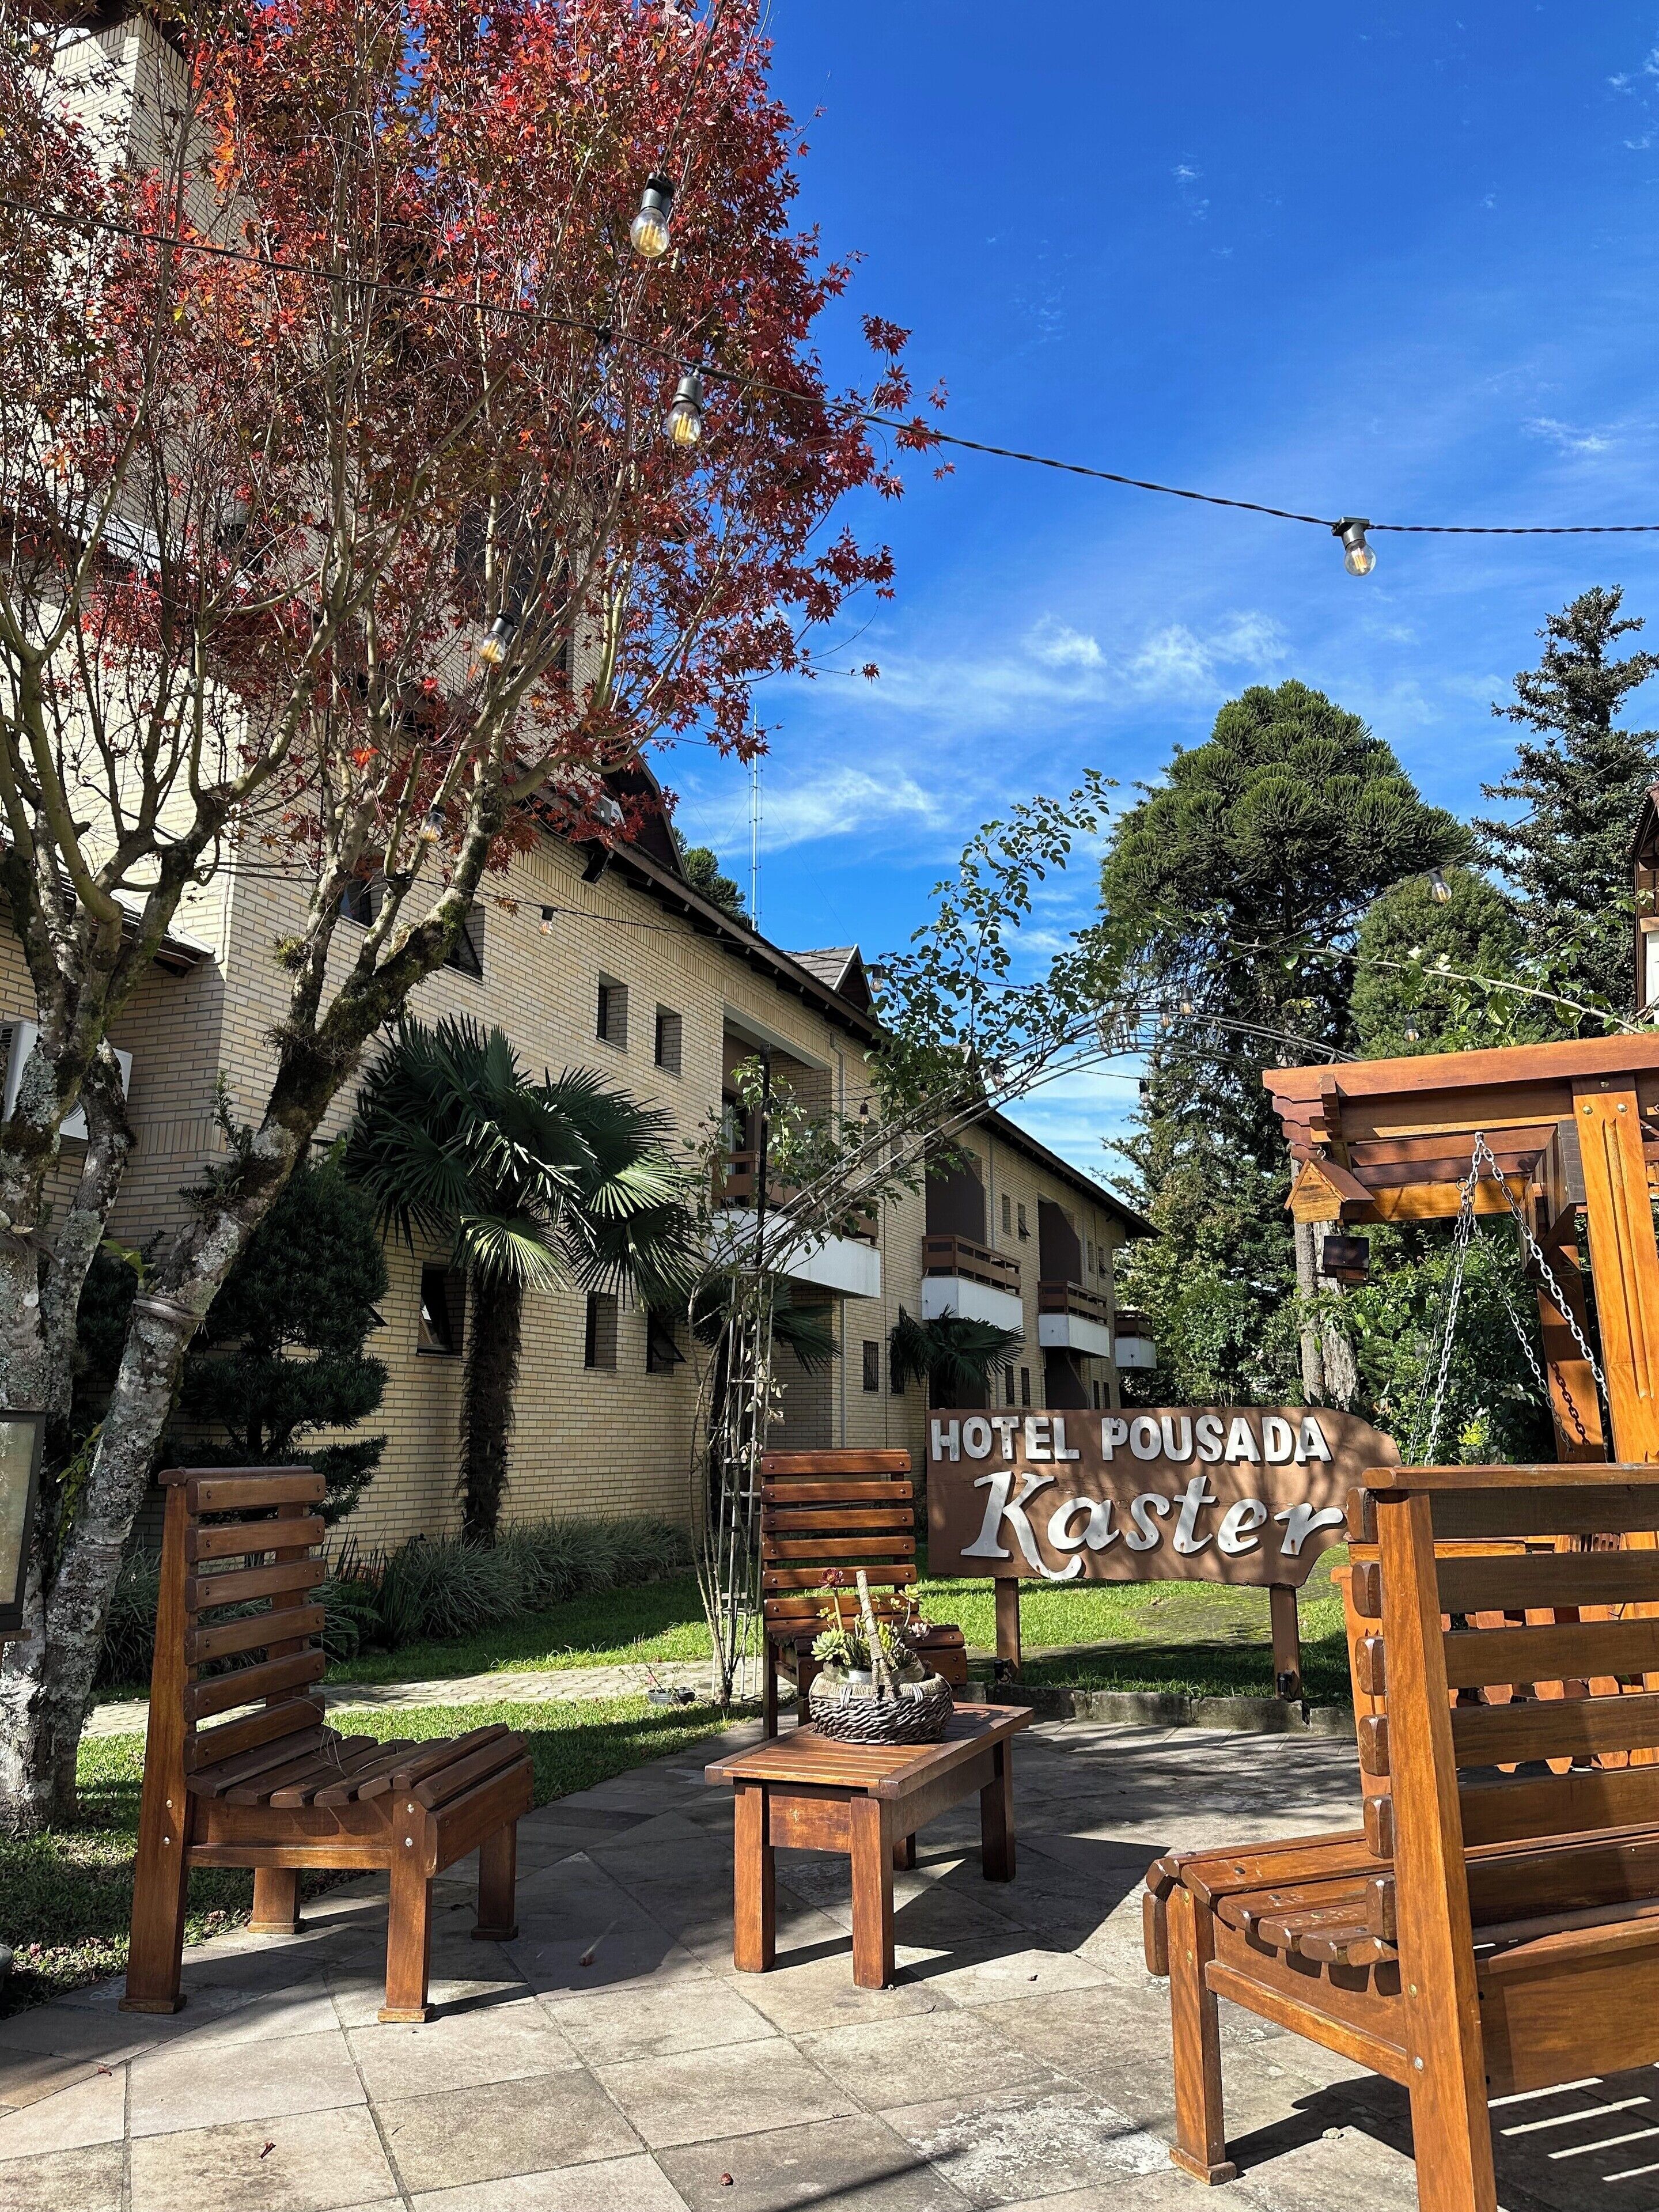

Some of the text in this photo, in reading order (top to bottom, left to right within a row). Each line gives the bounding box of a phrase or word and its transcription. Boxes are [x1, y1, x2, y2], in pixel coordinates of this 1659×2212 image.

[931, 1415, 1332, 1462] HOTEL POUSADA
[961, 1471, 1344, 1580] Kaster
